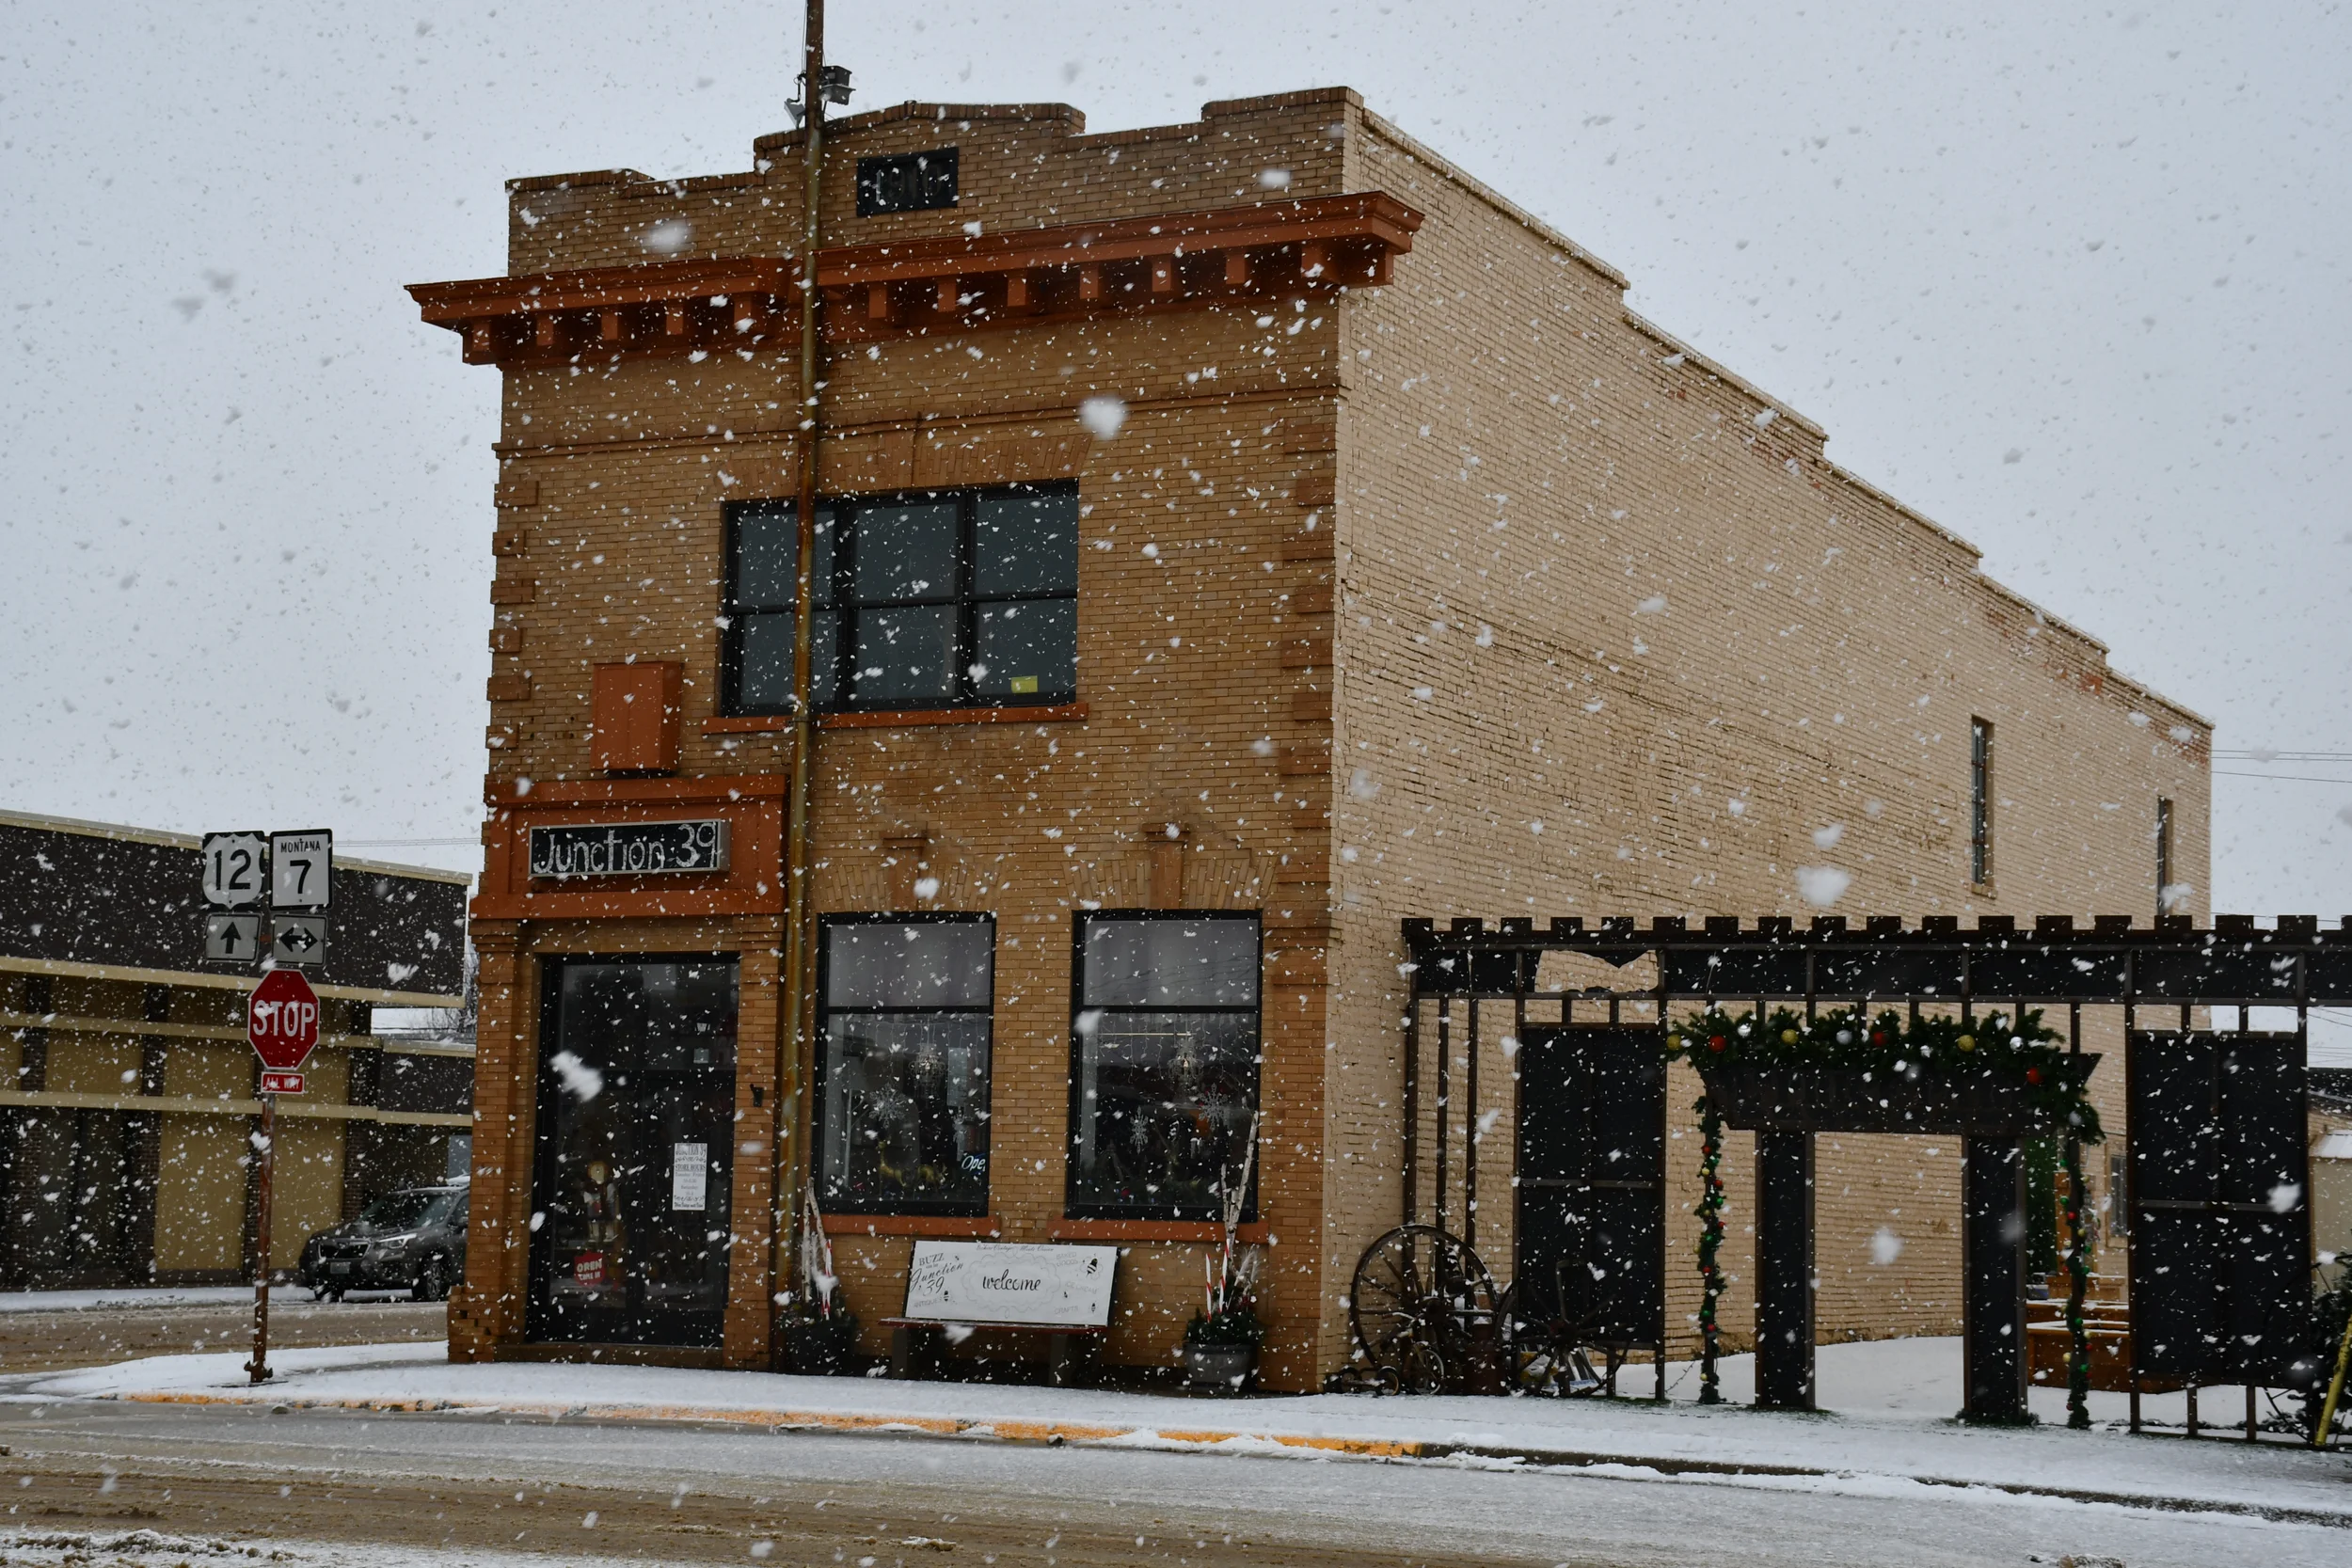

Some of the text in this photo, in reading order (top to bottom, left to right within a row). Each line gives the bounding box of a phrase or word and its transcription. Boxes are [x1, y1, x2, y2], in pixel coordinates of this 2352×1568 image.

[280, 839, 321, 853] MONTANA
[532, 821, 717, 875] Junction 39
[215, 848, 251, 891] 12
[290, 859, 312, 895] 7
[253, 1000, 316, 1037] STOP
[961, 1155, 987, 1172] Ope
[577, 1258, 602, 1273] OPEN
[919, 1253, 945, 1267] BUZZ
[910, 1262, 963, 1292] Junction
[922, 1275, 946, 1296] 39
[982, 1268, 1041, 1291] welcome
